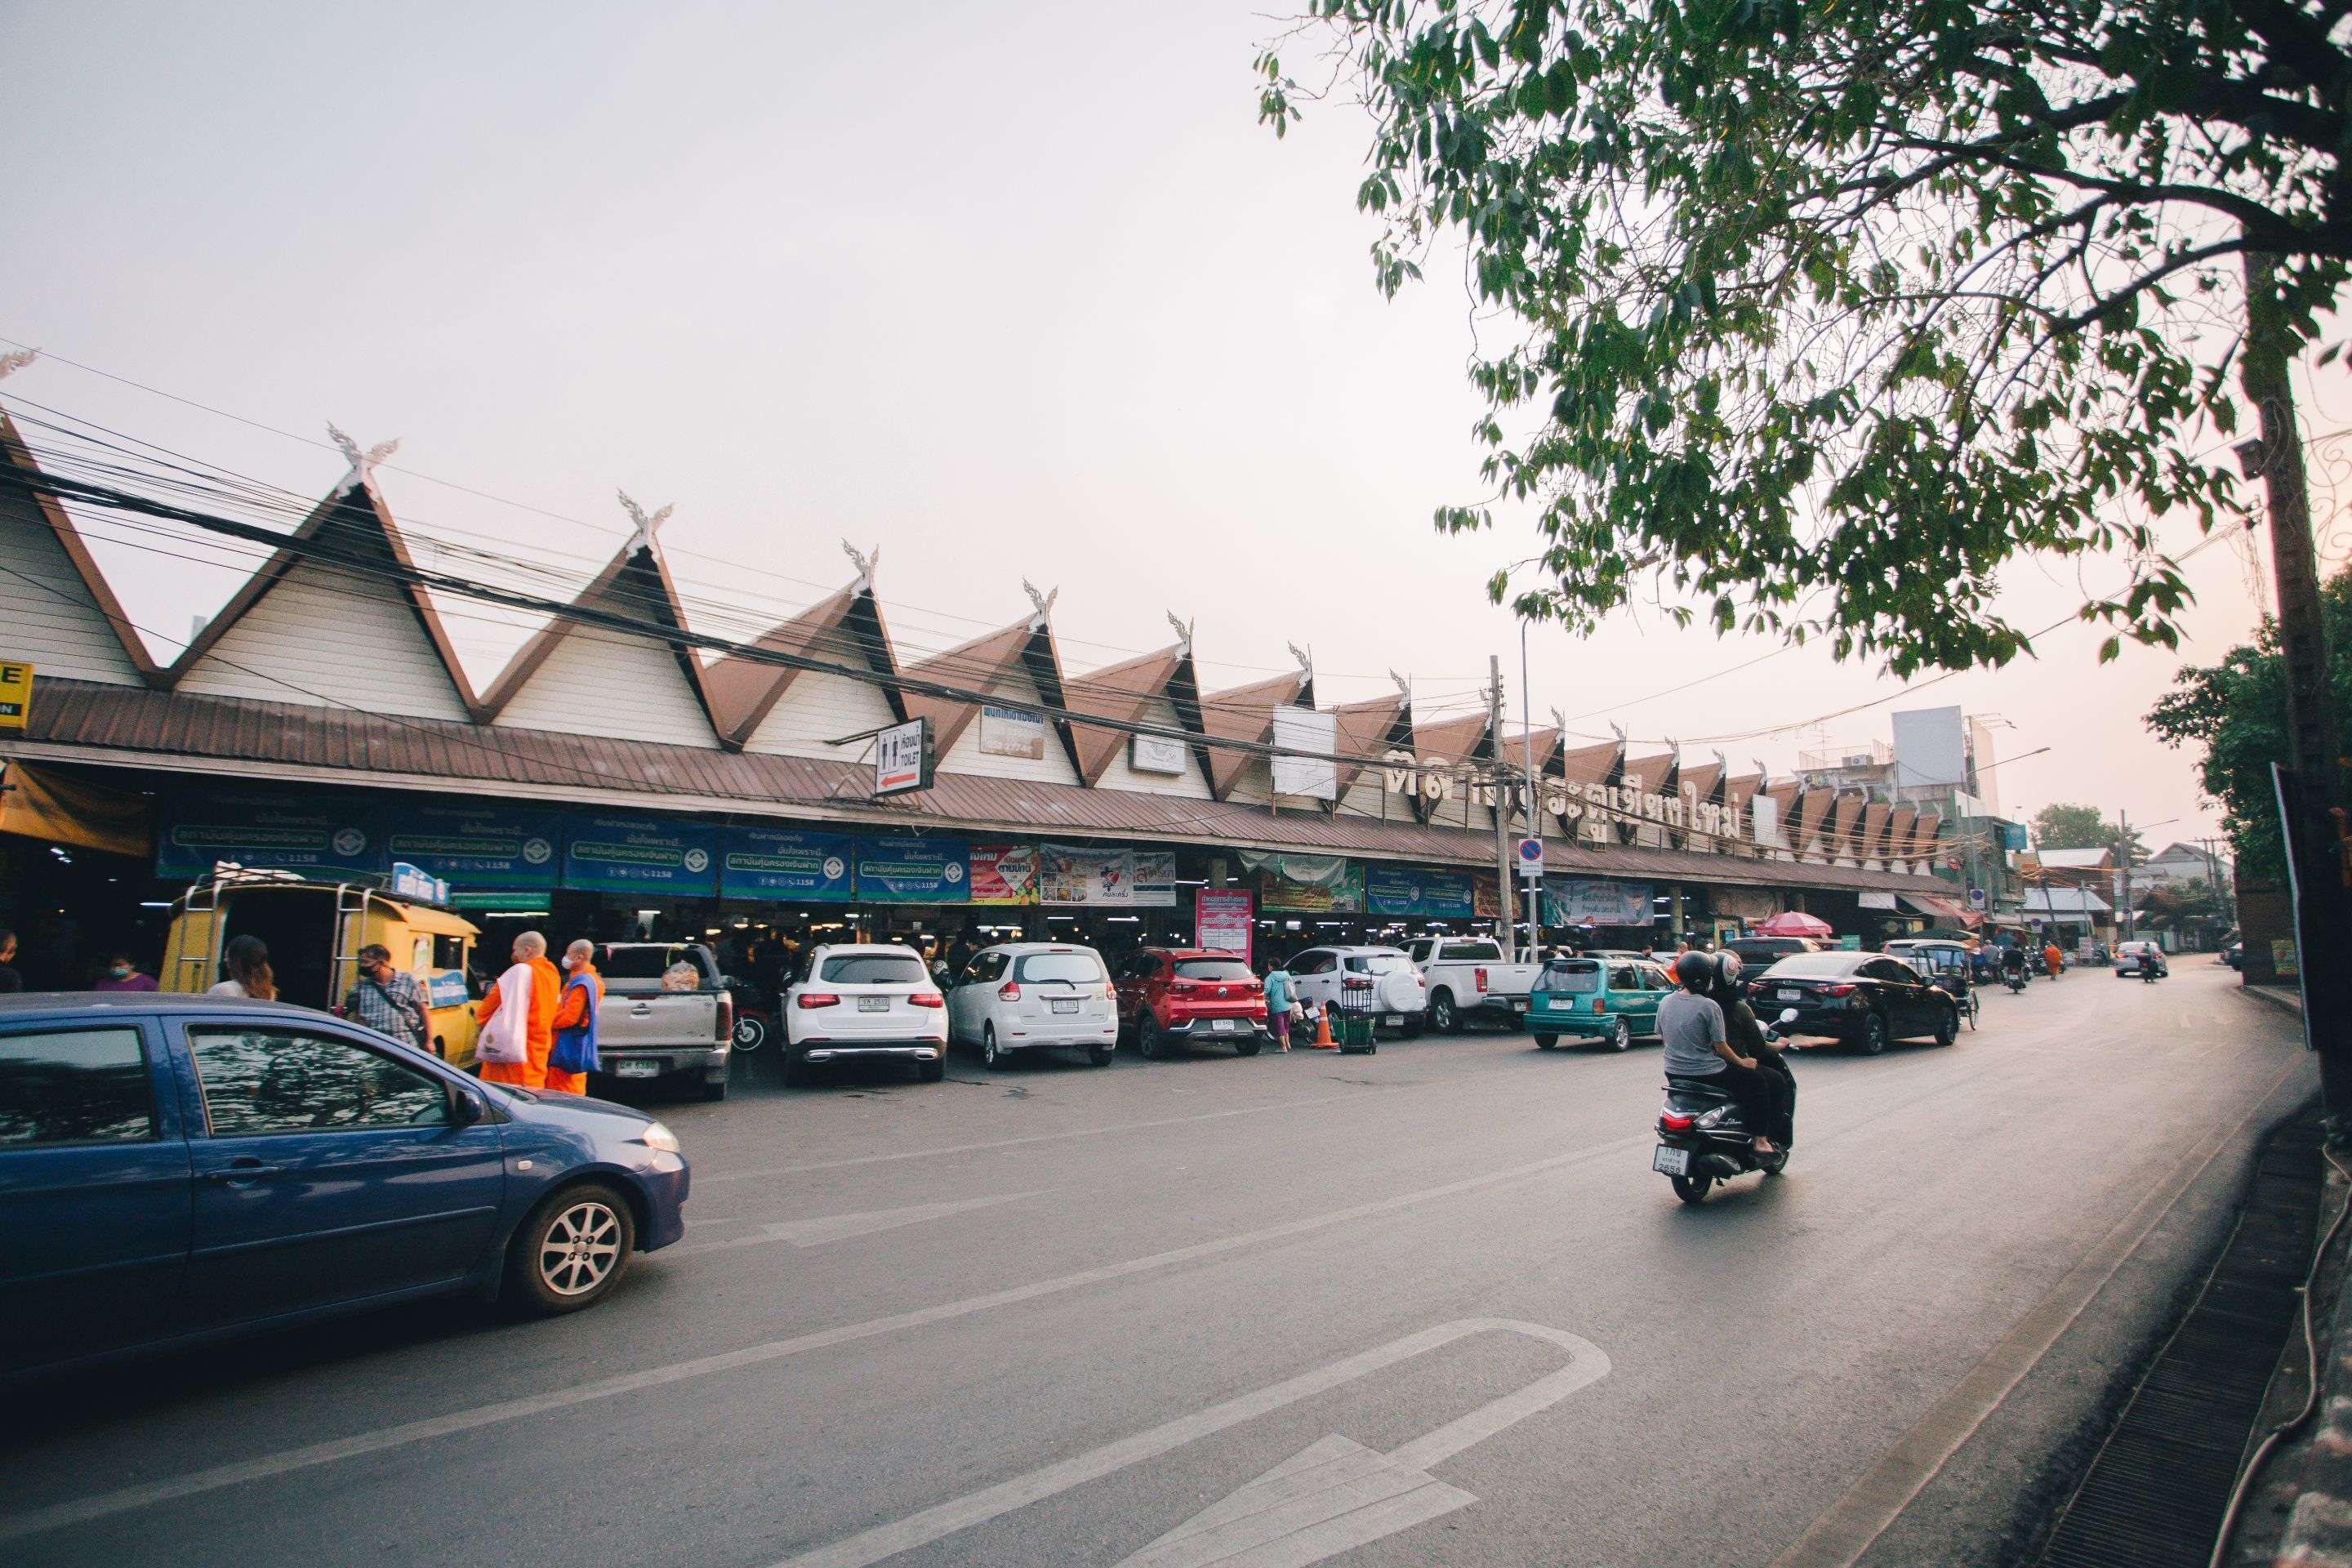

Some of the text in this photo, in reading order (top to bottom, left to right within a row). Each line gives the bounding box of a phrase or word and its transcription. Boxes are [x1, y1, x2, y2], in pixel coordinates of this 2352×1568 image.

[0, 705, 13, 714] N
[901, 725, 920, 750] ห้องน้ำ
[901, 751, 920, 768] TOILET
[730, 858, 818, 870] สถาบันคุ้มครองเงินฝาก
[650, 870, 672, 879] 1158
[863, 865, 941, 875] สถาบันคุ้มครองเงินฝาก
[796, 878, 815, 886] 1158
[1102, 888, 1129, 898] คนละครึ่ง
[1658, 1163, 1681, 1174] 2656
